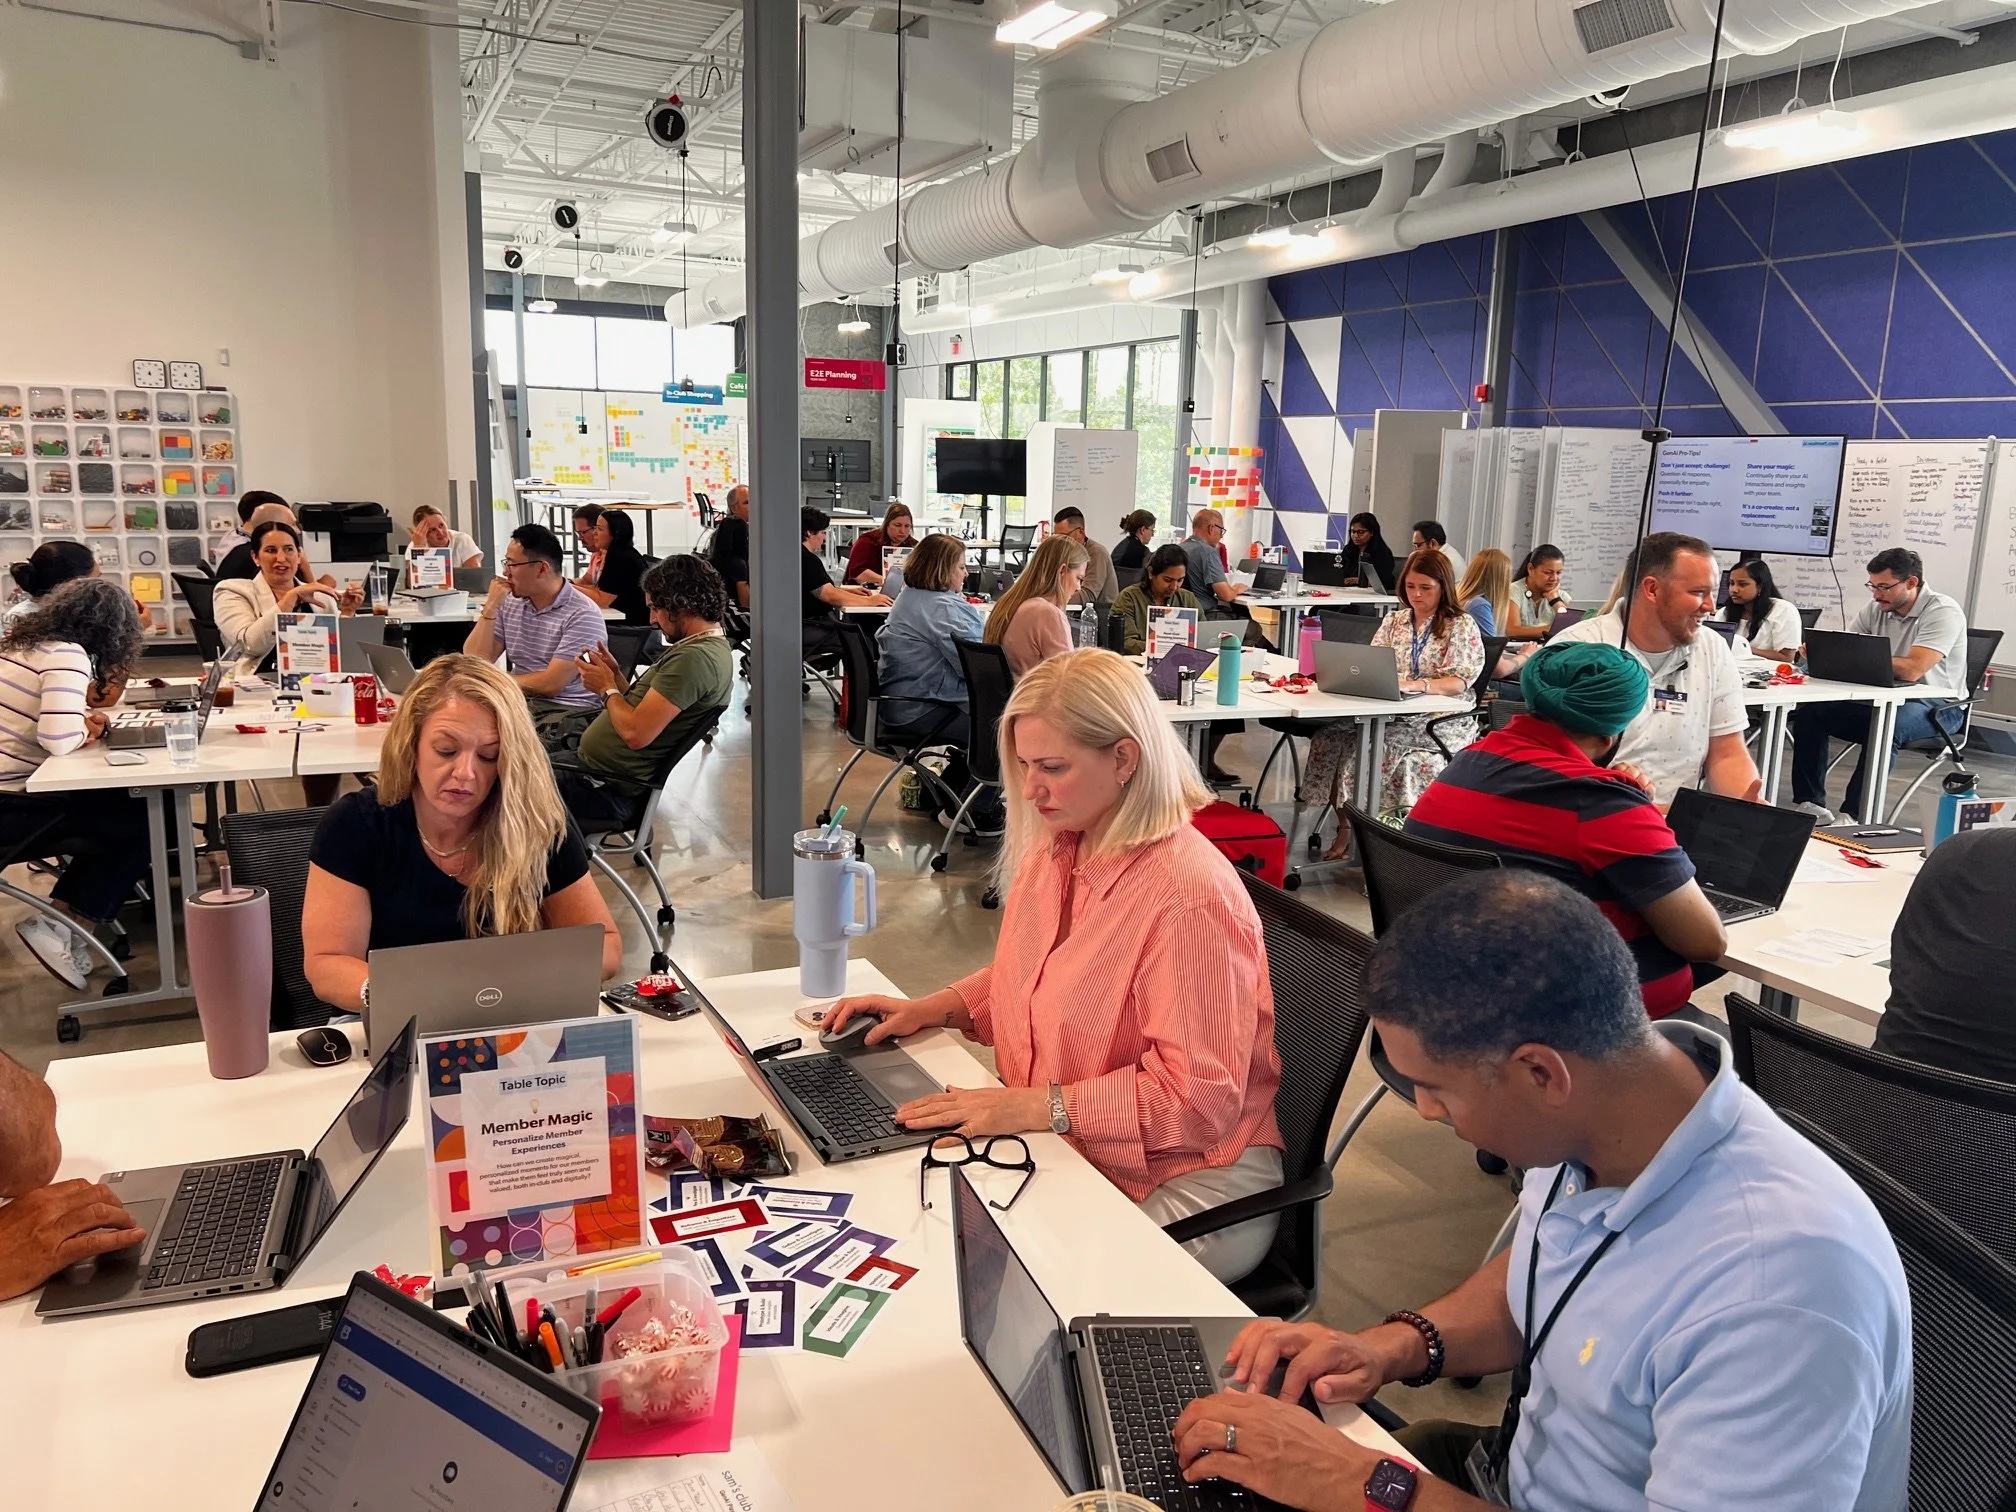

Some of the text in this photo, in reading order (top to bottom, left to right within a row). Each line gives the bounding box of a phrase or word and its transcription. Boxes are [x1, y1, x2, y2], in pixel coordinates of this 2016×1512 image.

[825, 371, 857, 380] Planning
[1746, 472, 1773, 480] Continually
[1771, 523, 1794, 531] ingenuity
[501, 1075, 566, 1091] Table Topic
[481, 1111, 593, 1135] Member Magic
[493, 1129, 583, 1147] Personalize Member
[512, 1142, 566, 1155] Experiences
[480, 1169, 519, 1180] personalized
[564, 1173, 591, 1182] digitally?
[722, 1469, 751, 1511] sam's club
